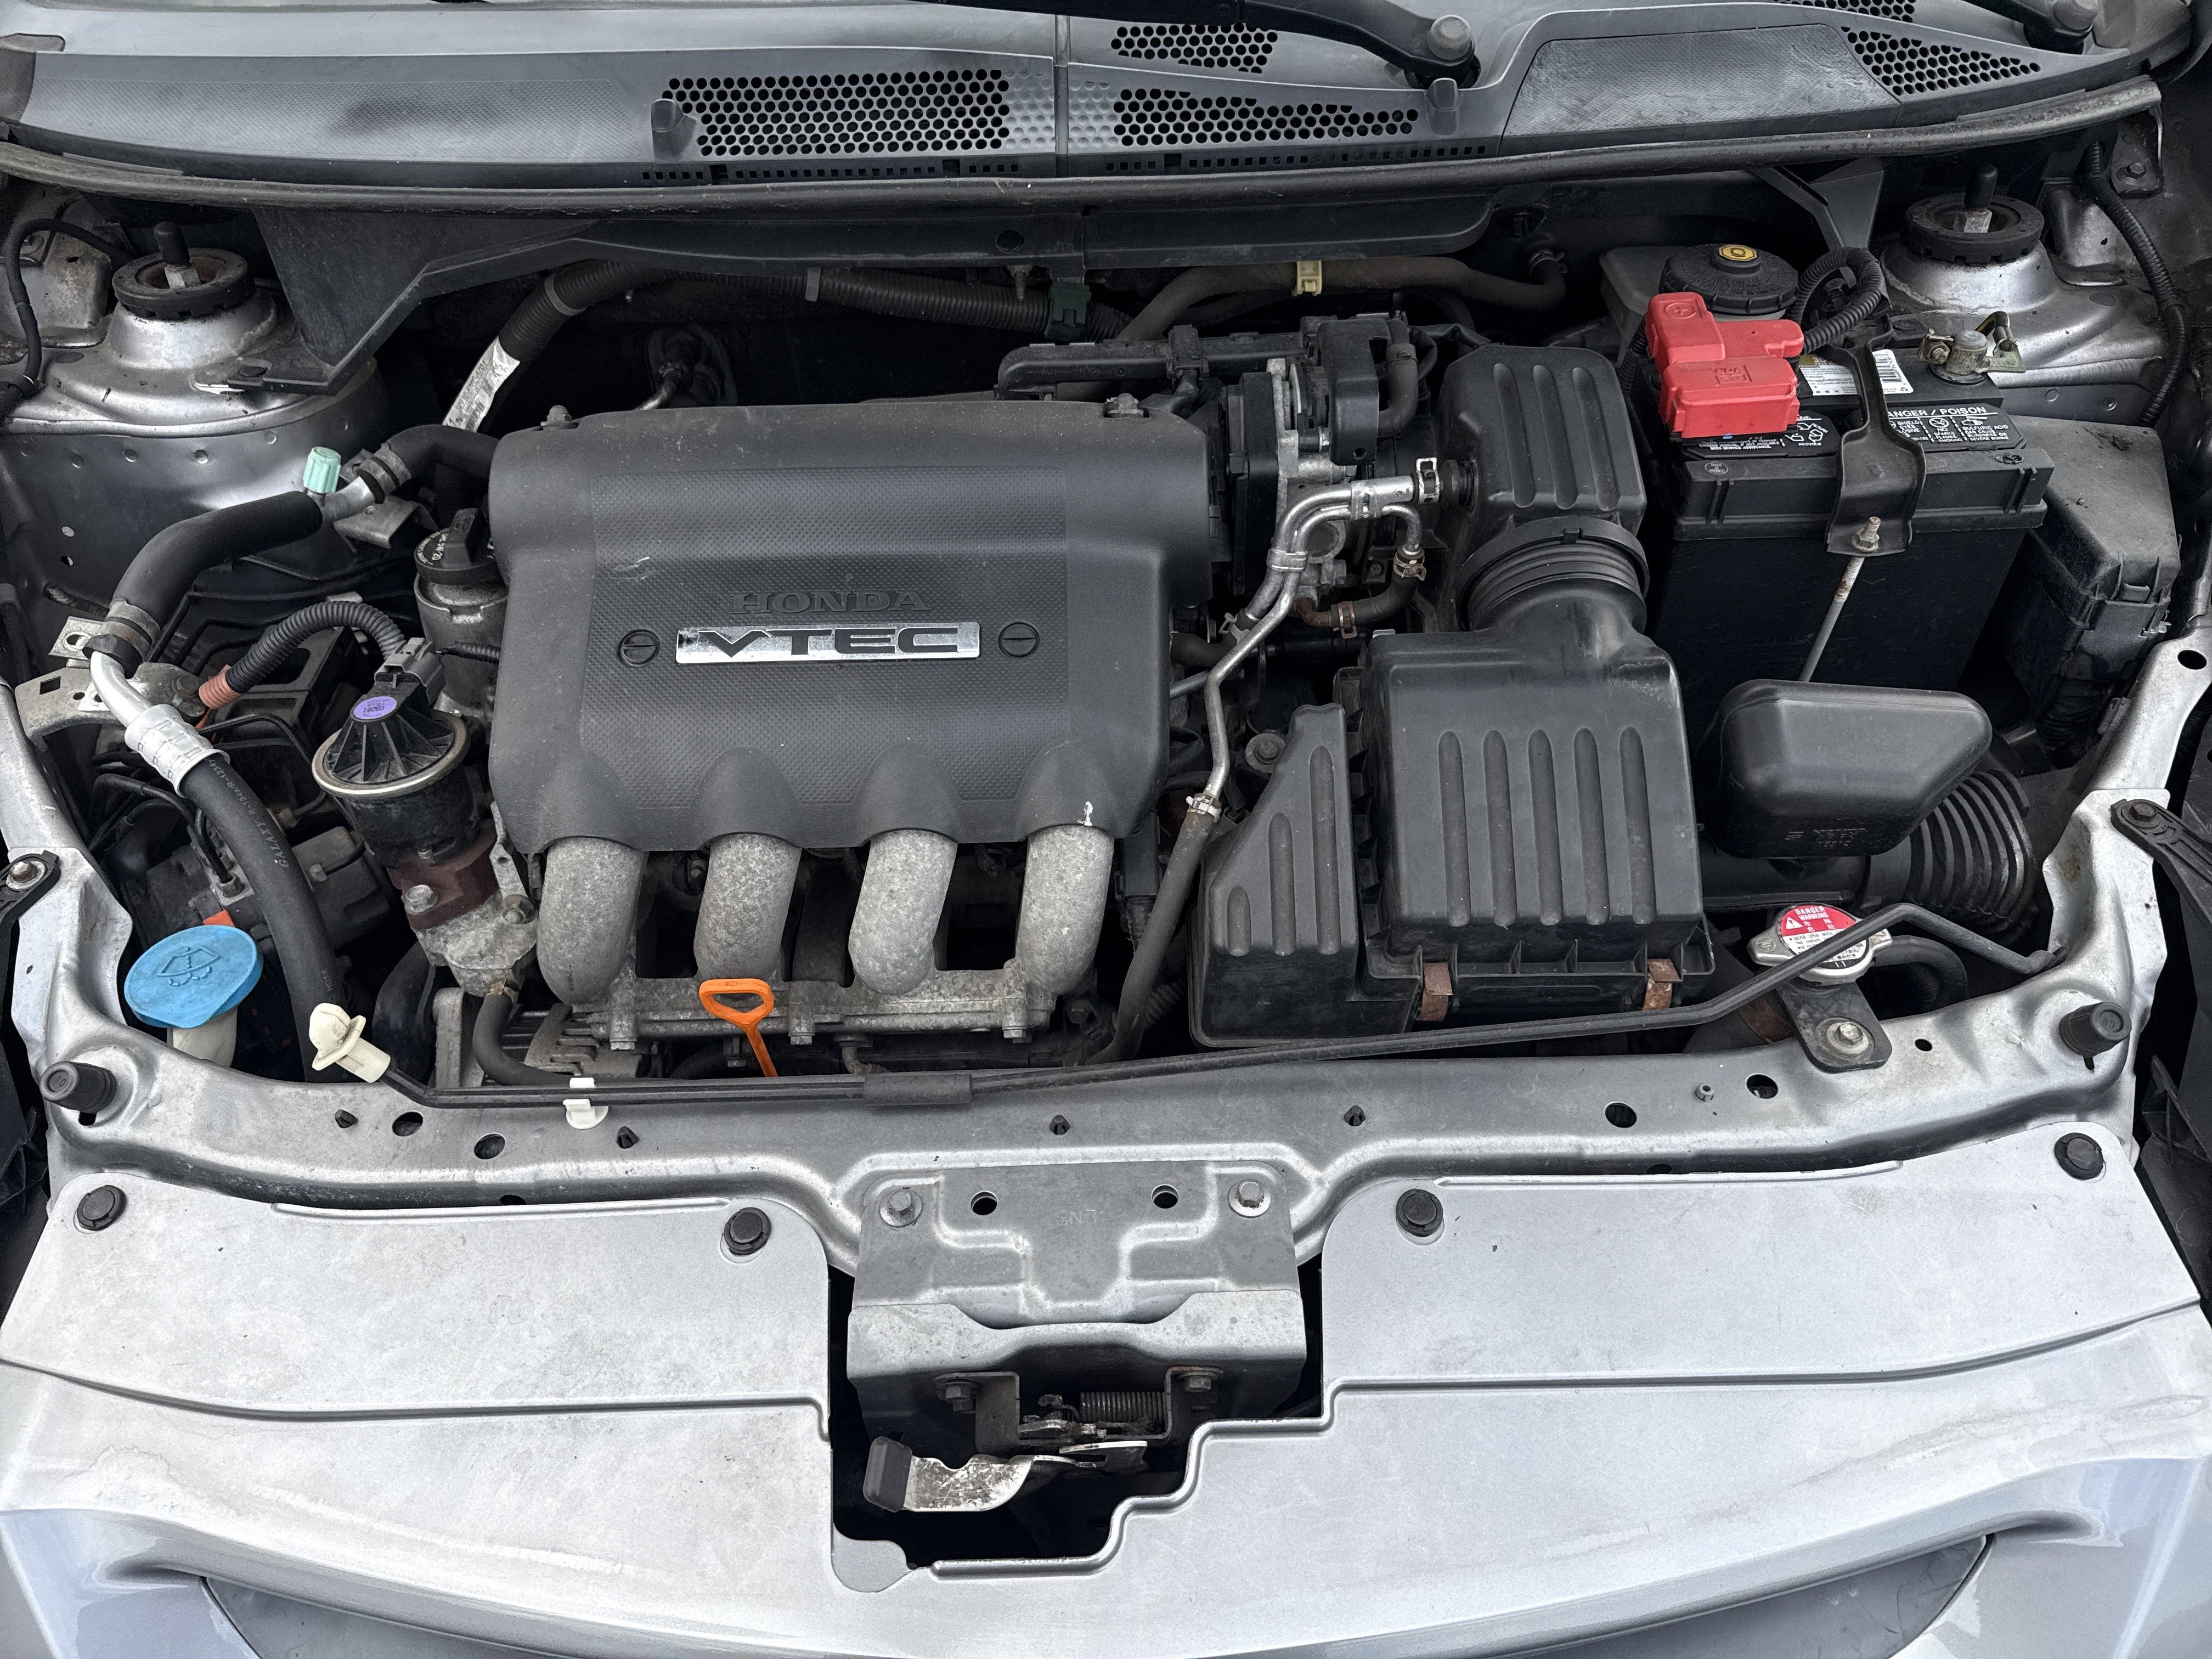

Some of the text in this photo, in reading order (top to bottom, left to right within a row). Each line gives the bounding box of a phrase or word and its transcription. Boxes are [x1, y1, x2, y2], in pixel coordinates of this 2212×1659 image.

[1939, 407, 1987, 415] POISON
[729, 589, 933, 615] HONDA
[698, 626, 959, 658] VTEC
[254, 820, 290, 868] GALAXY
[1794, 906, 1826, 916] DANGER
[1798, 912, 1829, 922] WARNUNG
